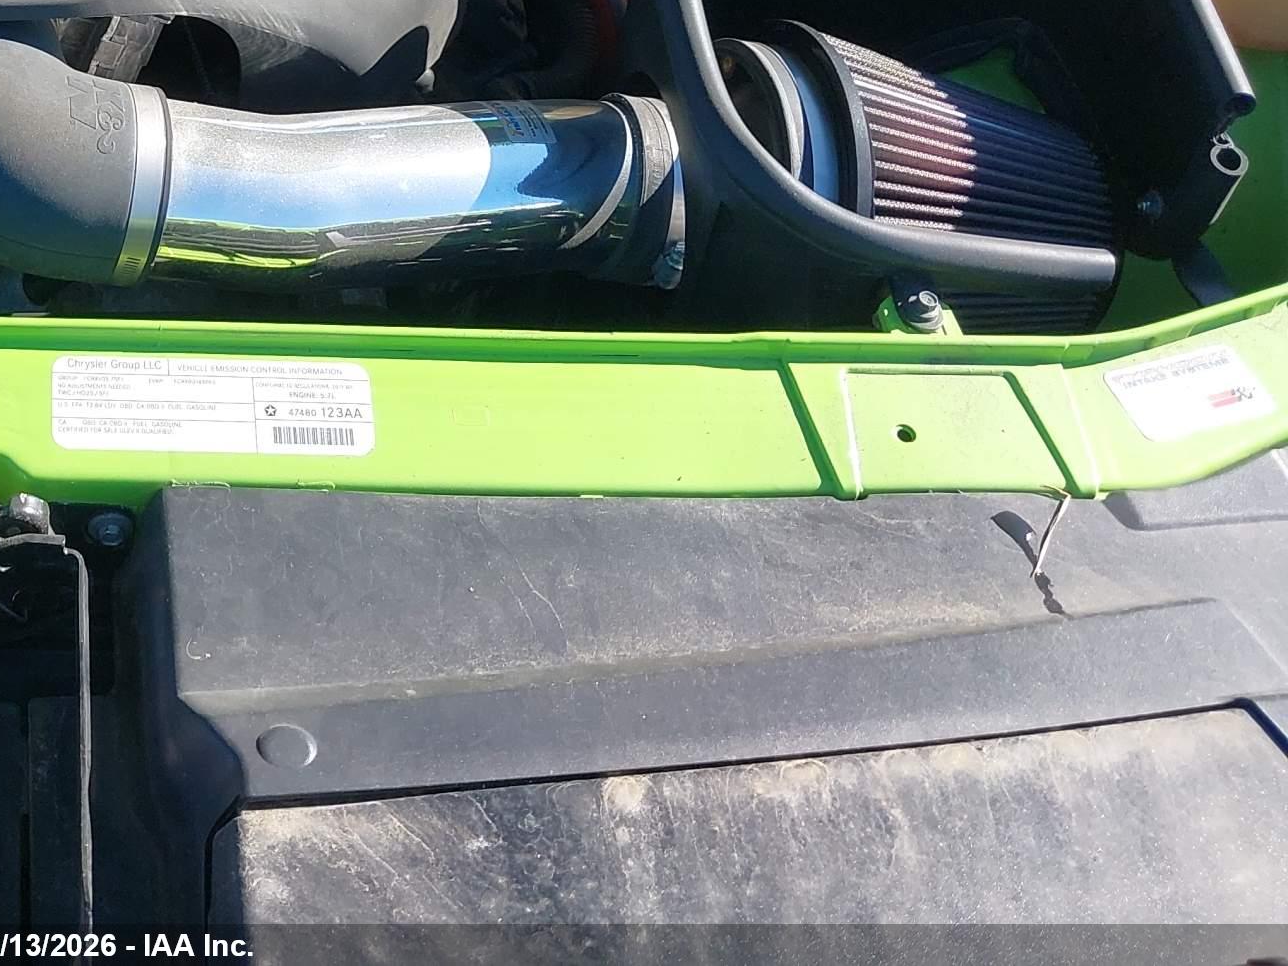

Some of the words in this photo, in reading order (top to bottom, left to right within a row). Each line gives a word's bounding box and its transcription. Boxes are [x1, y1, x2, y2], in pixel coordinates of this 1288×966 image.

[67, 358, 108, 371] Chrysler
[110, 359, 142, 372] Group
[143, 360, 162, 371] LLC
[177, 364, 208, 372] VEHICLE
[210, 365, 248, 373] EMISSION
[250, 366, 287, 374] CONTROL
[289, 367, 343, 376] INFORMATION
[320, 407, 363, 419] 123AA
